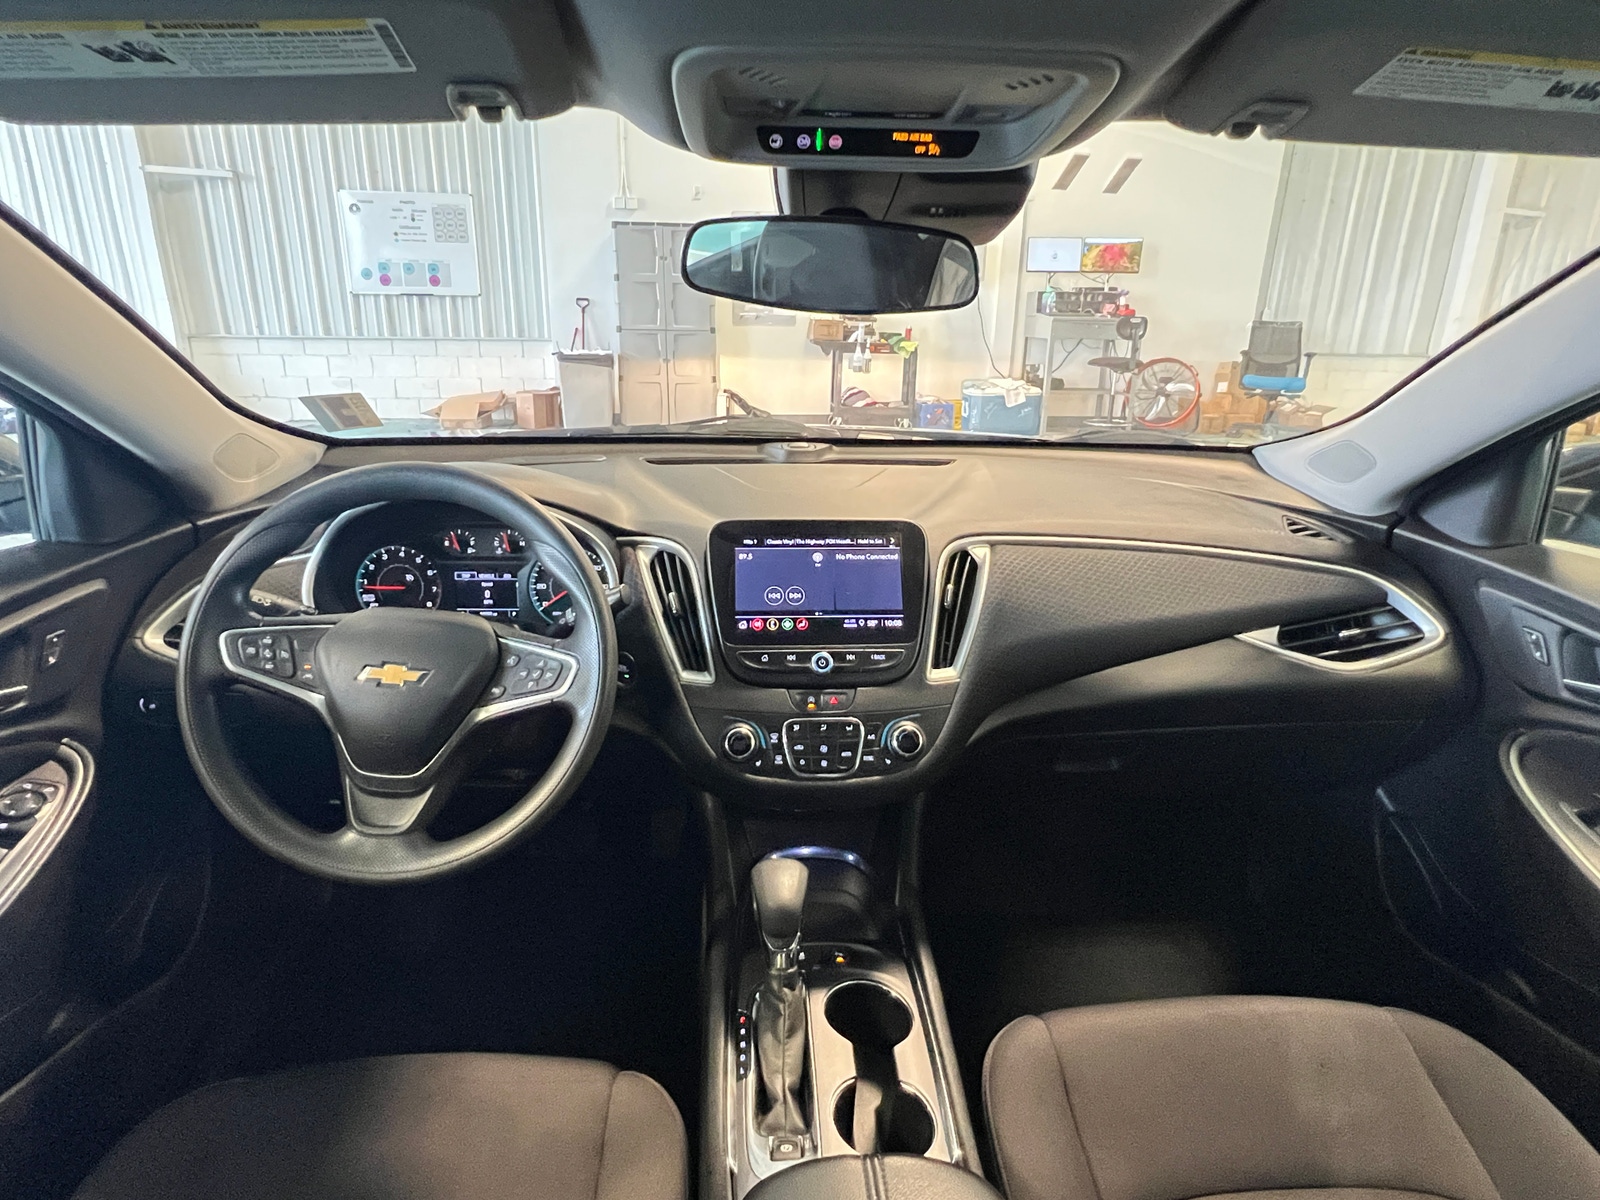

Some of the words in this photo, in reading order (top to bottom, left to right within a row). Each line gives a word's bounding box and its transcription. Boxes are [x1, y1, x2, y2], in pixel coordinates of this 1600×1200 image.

[805, 538, 825, 547] Highway
[738, 553, 753, 561] 89.5
[484, 589, 491, 598] 0
